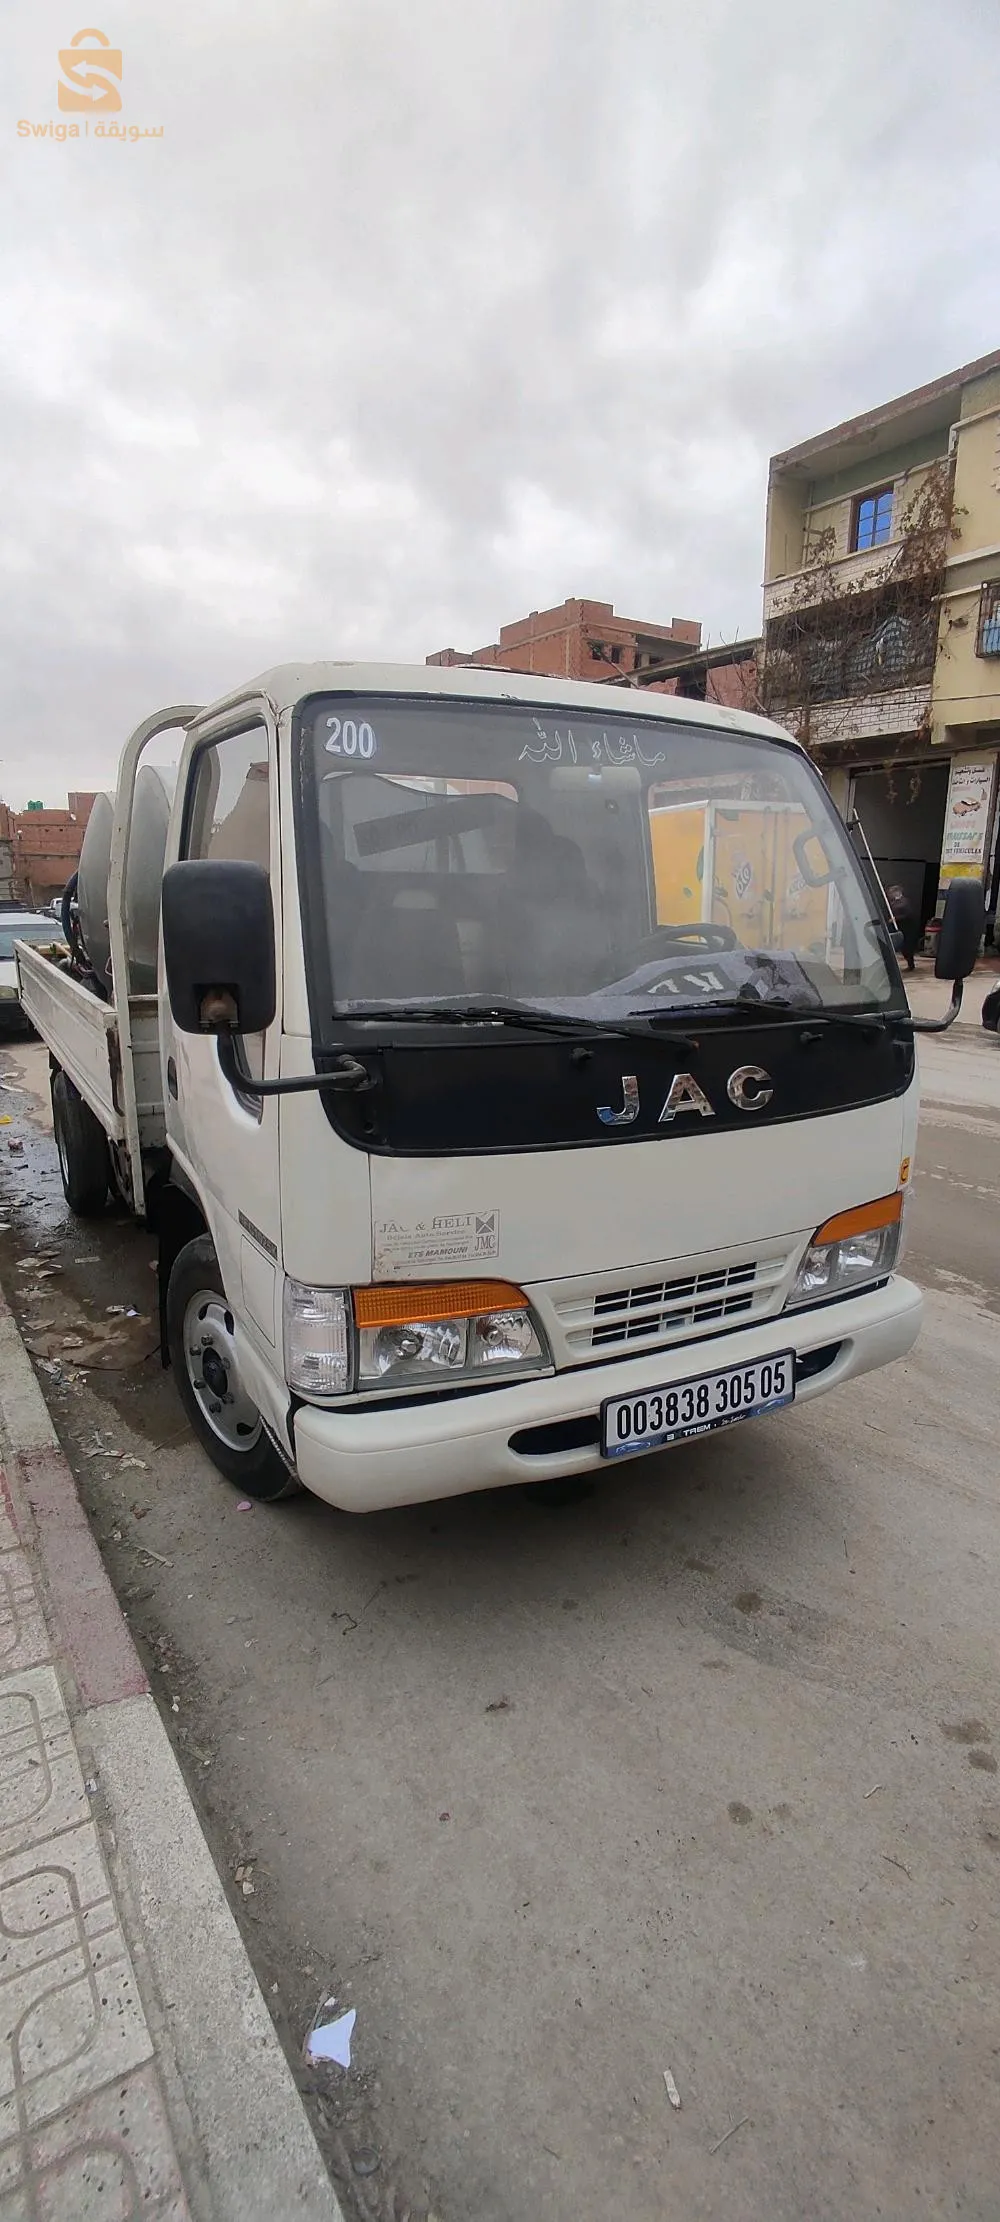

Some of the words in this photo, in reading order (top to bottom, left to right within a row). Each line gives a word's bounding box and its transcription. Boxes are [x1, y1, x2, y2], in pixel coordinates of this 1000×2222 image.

[325, 717, 373, 758] 200
[518, 716, 577, 764] الله
[596, 1065, 774, 1126] JAC
[415, 1222, 426, 1231] &
[474, 1234, 497, 1252] JMC
[425, 1246, 469, 1258] MAMOUNI
[616, 1384, 709, 1439] 003838
[715, 1370, 755, 1413] 305
[760, 1360, 786, 1399] 05
